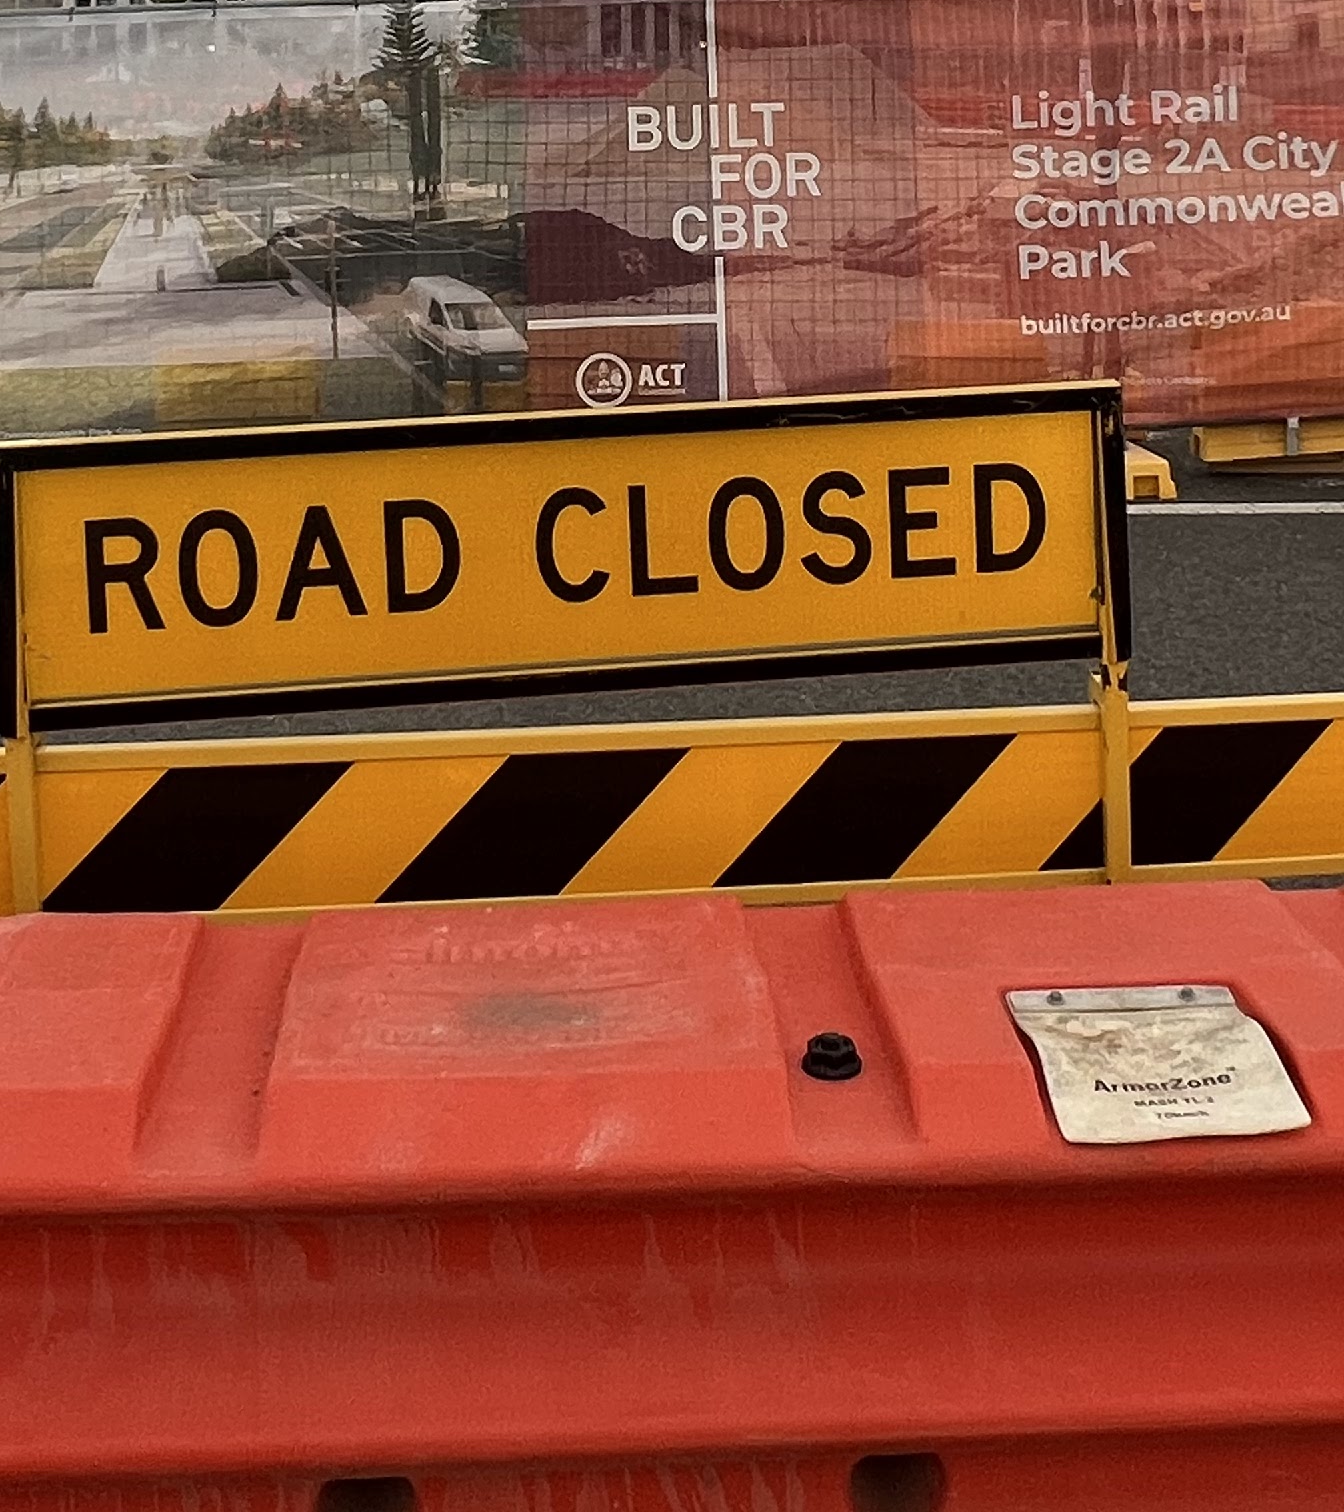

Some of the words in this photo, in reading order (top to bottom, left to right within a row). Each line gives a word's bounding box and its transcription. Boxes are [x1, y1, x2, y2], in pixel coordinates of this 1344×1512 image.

[627, 102, 785, 151] BUILT
[1011, 90, 1136, 136] Light
[1150, 84, 1238, 126] Rail
[711, 152, 821, 199] FOR
[1012, 144, 1152, 185] Stage
[1164, 138, 1231, 175] 2A
[1242, 130, 1338, 177] City
[672, 204, 788, 252] CBR
[1017, 240, 1131, 280] Park
[1020, 303, 1292, 336] builtforcbr.act.gov.au
[638, 362, 686, 386] ACT
[84, 498, 461, 634] ROAD
[535, 462, 1047, 605] CLOSED
